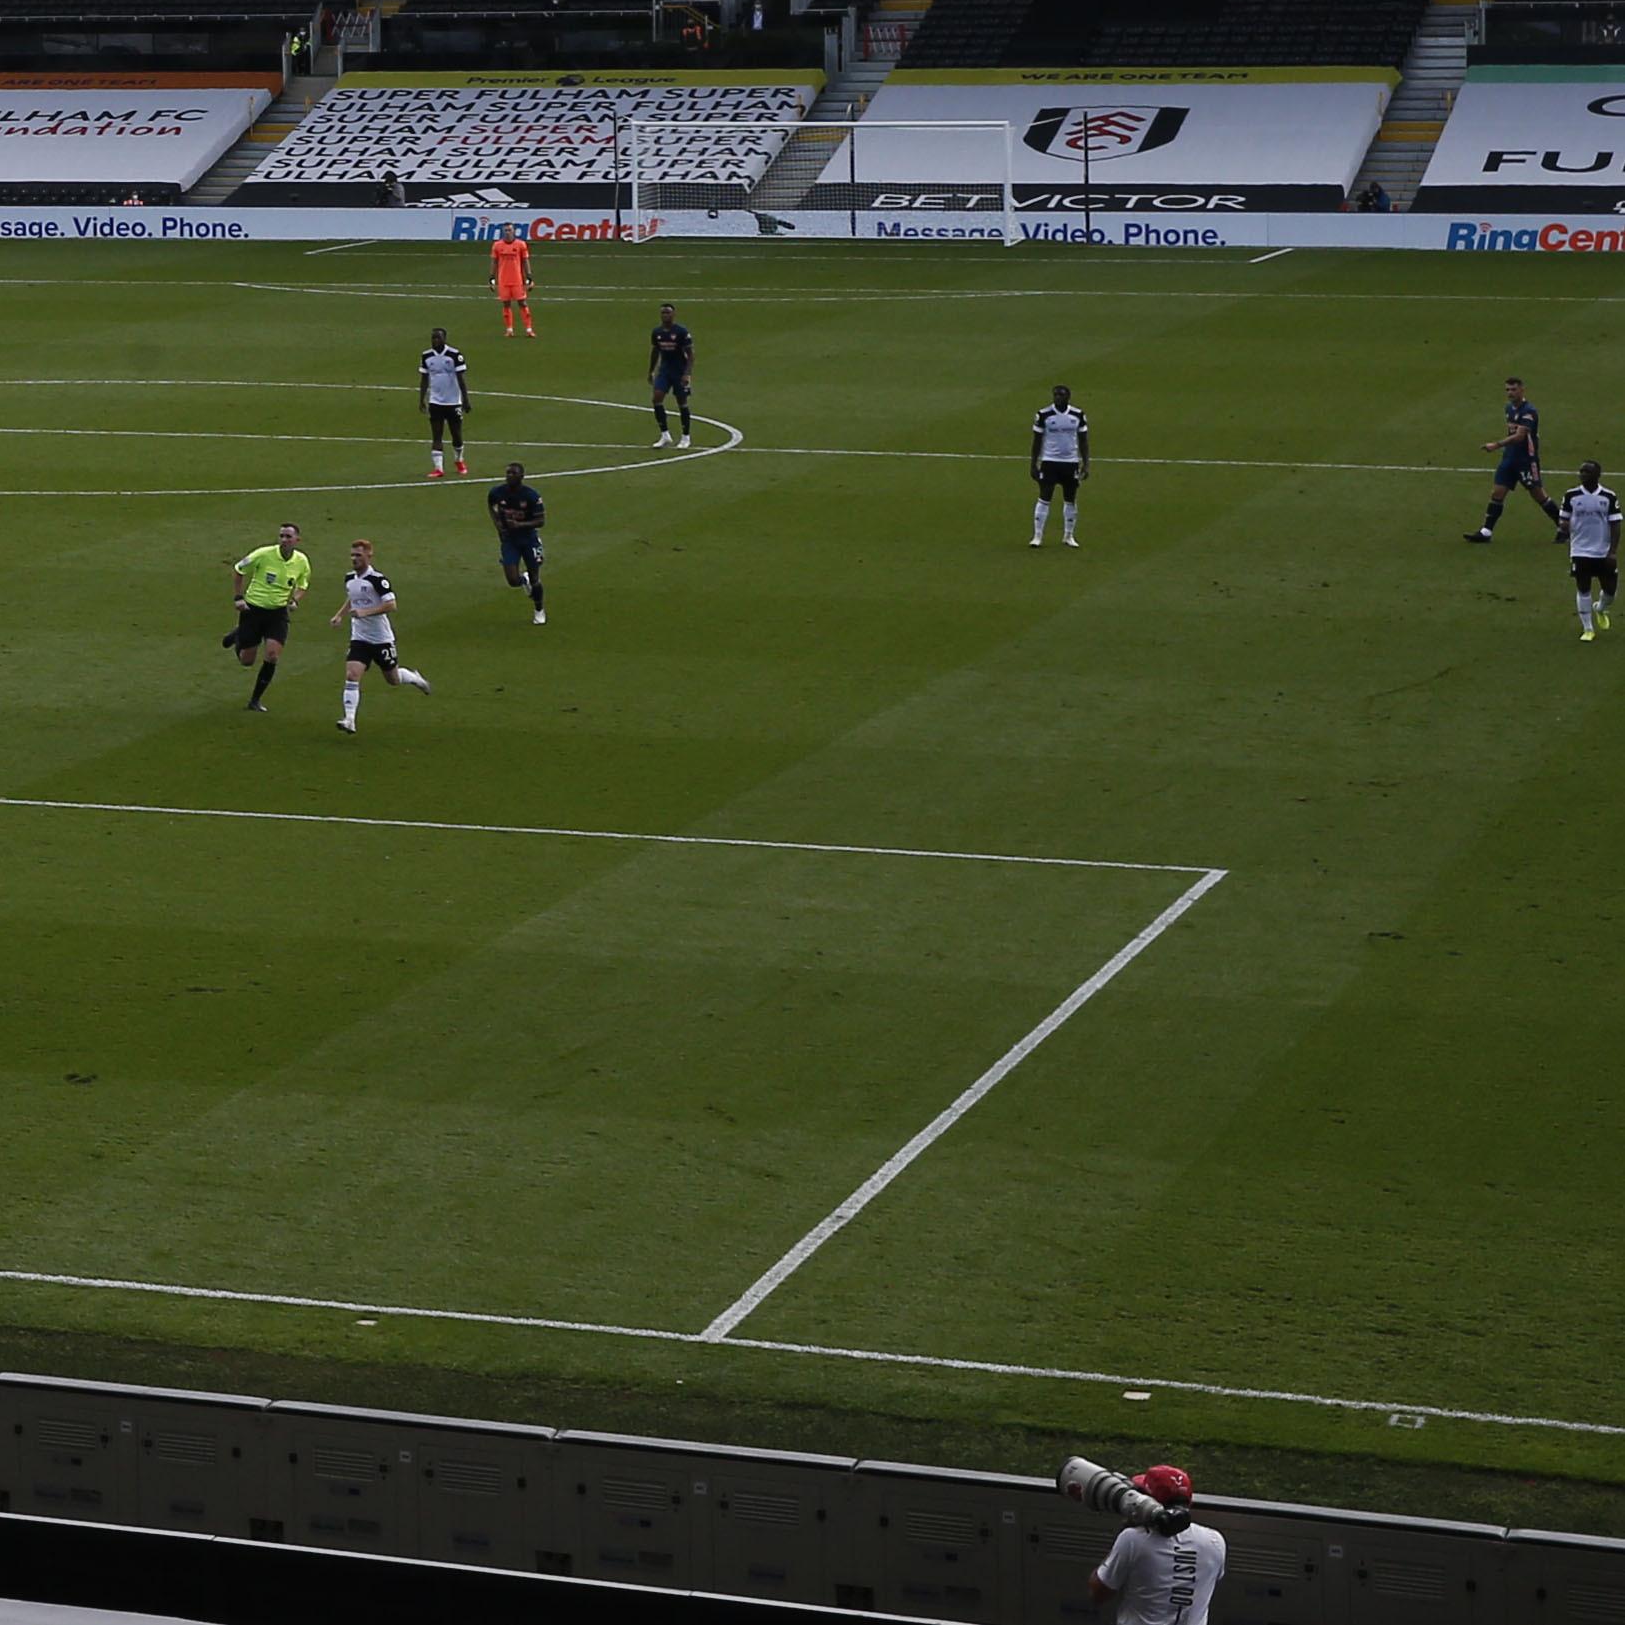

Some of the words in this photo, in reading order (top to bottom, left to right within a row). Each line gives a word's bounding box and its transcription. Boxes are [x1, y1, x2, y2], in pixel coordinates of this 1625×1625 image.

[1, 78, 45, 86] ARE
[47, 78, 93, 86] ONE
[95, 78, 159, 86] TEAM
[465, 76, 549, 86] Premier
[591, 75, 677, 84] League
[1021, 73, 1058, 81] WE
[1065, 73, 1114, 81] ARE
[1119, 73, 1172, 81] ONE
[1179, 72, 1249, 80] TEAM
[333, 88, 461, 102] SUPER
[473, 87, 651, 102] FULHAM
[661, 87, 796, 101] SUPER
[147, 108, 210, 122] FC
[484, 101, 616, 114] SUPER
[631, 100, 807, 118] FULHAM
[314, 113, 441, 124] SUPER
[460, 112, 634, 125] FULHAM
[648, 111, 780, 124] SUPER
[465, 124, 599, 136] SUPER
[291, 135, 422, 147] SUPER
[436, 134, 616, 146] FULHAM
[446, 146, 581, 158] SUPER
[270, 158, 402, 170] SUPER
[416, 158, 596, 170] FULHAM
[1482, 150, 1625, 173] FU
[425, 169, 562, 181] SUPER
[404, 199, 530, 208] adidas
[870, 192, 1248, 211] BETVICTOR
[72, 216, 155, 239] Video.
[161, 216, 250, 239] Phone.
[1124, 223, 1227, 246] Phone.
[1173, 1546, 1198, 1583] JUST
[1169, 1586, 1194, 1607] DO
